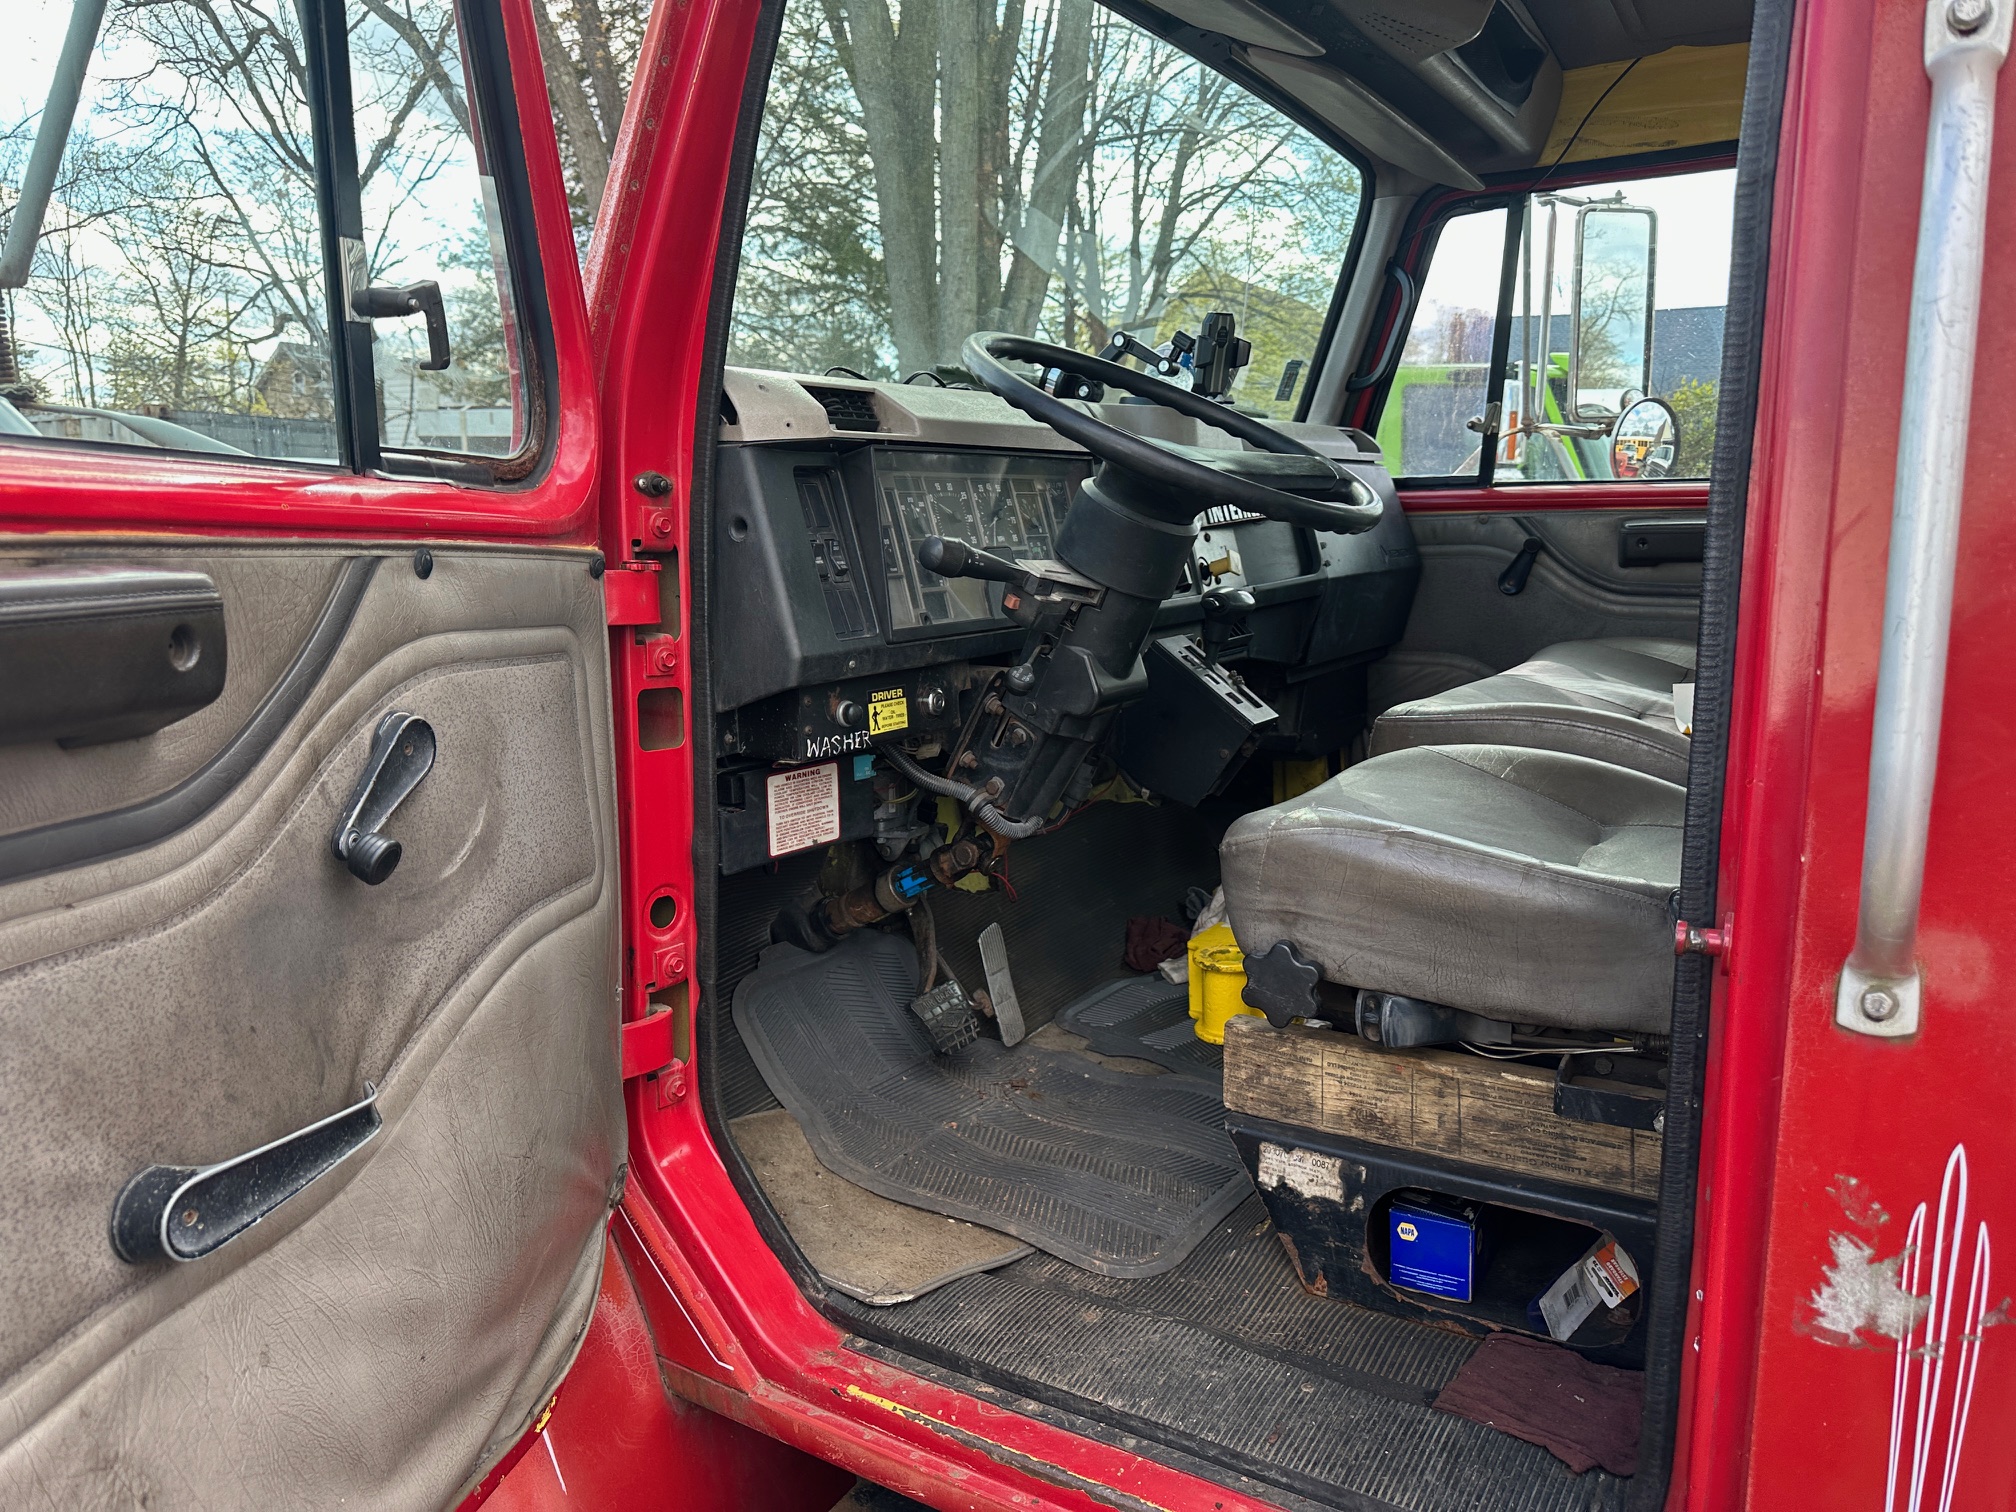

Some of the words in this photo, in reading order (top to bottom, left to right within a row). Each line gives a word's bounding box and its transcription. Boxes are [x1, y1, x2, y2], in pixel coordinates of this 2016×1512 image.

[871, 688, 903, 702] DRIVER
[807, 730, 872, 758] WASHER
[785, 769, 820, 781] WARNING
[1400, 1227, 1414, 1237] NAPA
